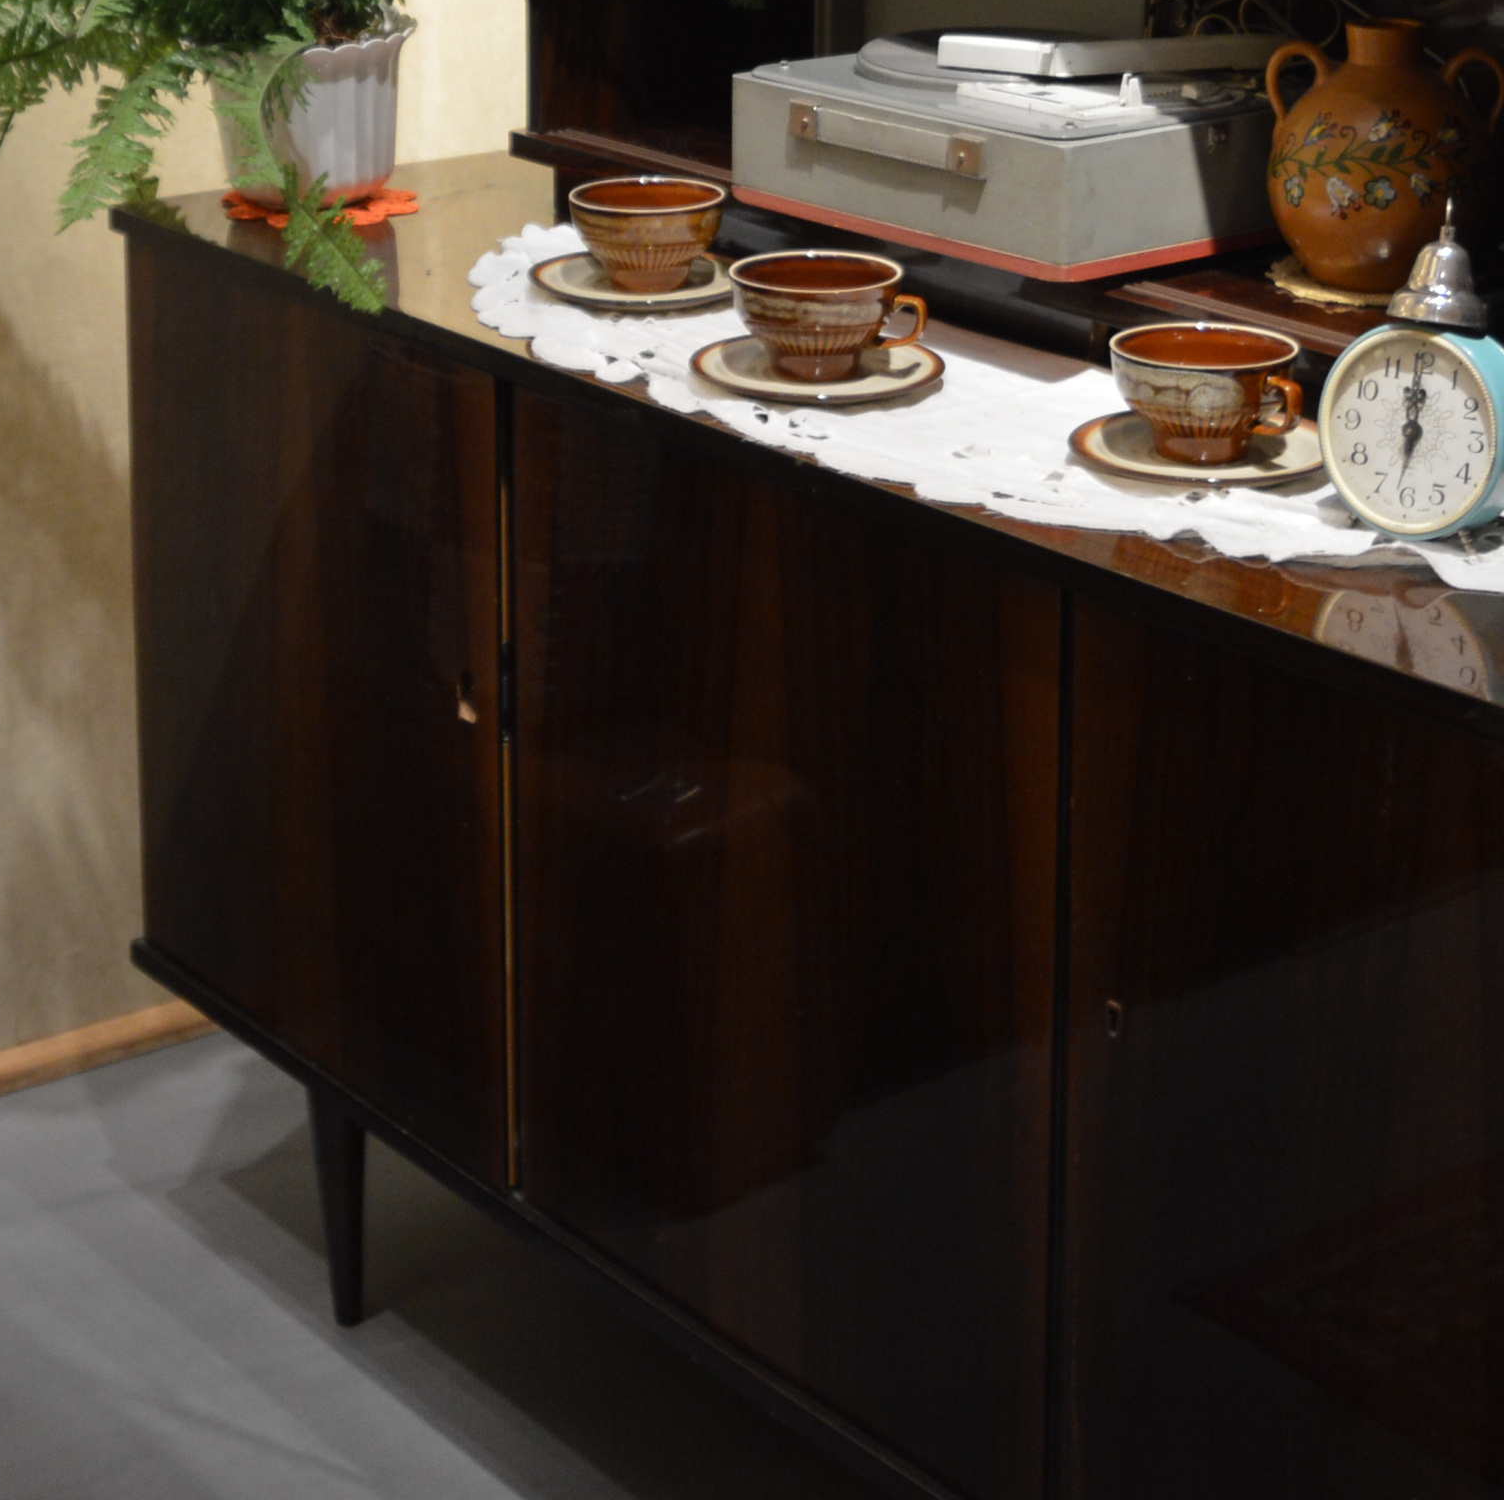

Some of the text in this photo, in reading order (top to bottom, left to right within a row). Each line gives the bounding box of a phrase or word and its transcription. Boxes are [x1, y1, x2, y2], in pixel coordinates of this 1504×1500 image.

[1384, 357, 1401, 380] 11
[1451, 369, 1459, 390] 1
[1357, 379, 1379, 401] 10
[1344, 408, 1361, 430] 9
[1463, 398, 1480, 421] 2
[1467, 430, 1485, 454] 3
[1350, 442, 1368, 466] 8
[1373, 471, 1388, 494] 7
[1454, 462, 1472, 485] 4
[1399, 486, 1416, 509] 6
[1428, 483, 1446, 506] 5
